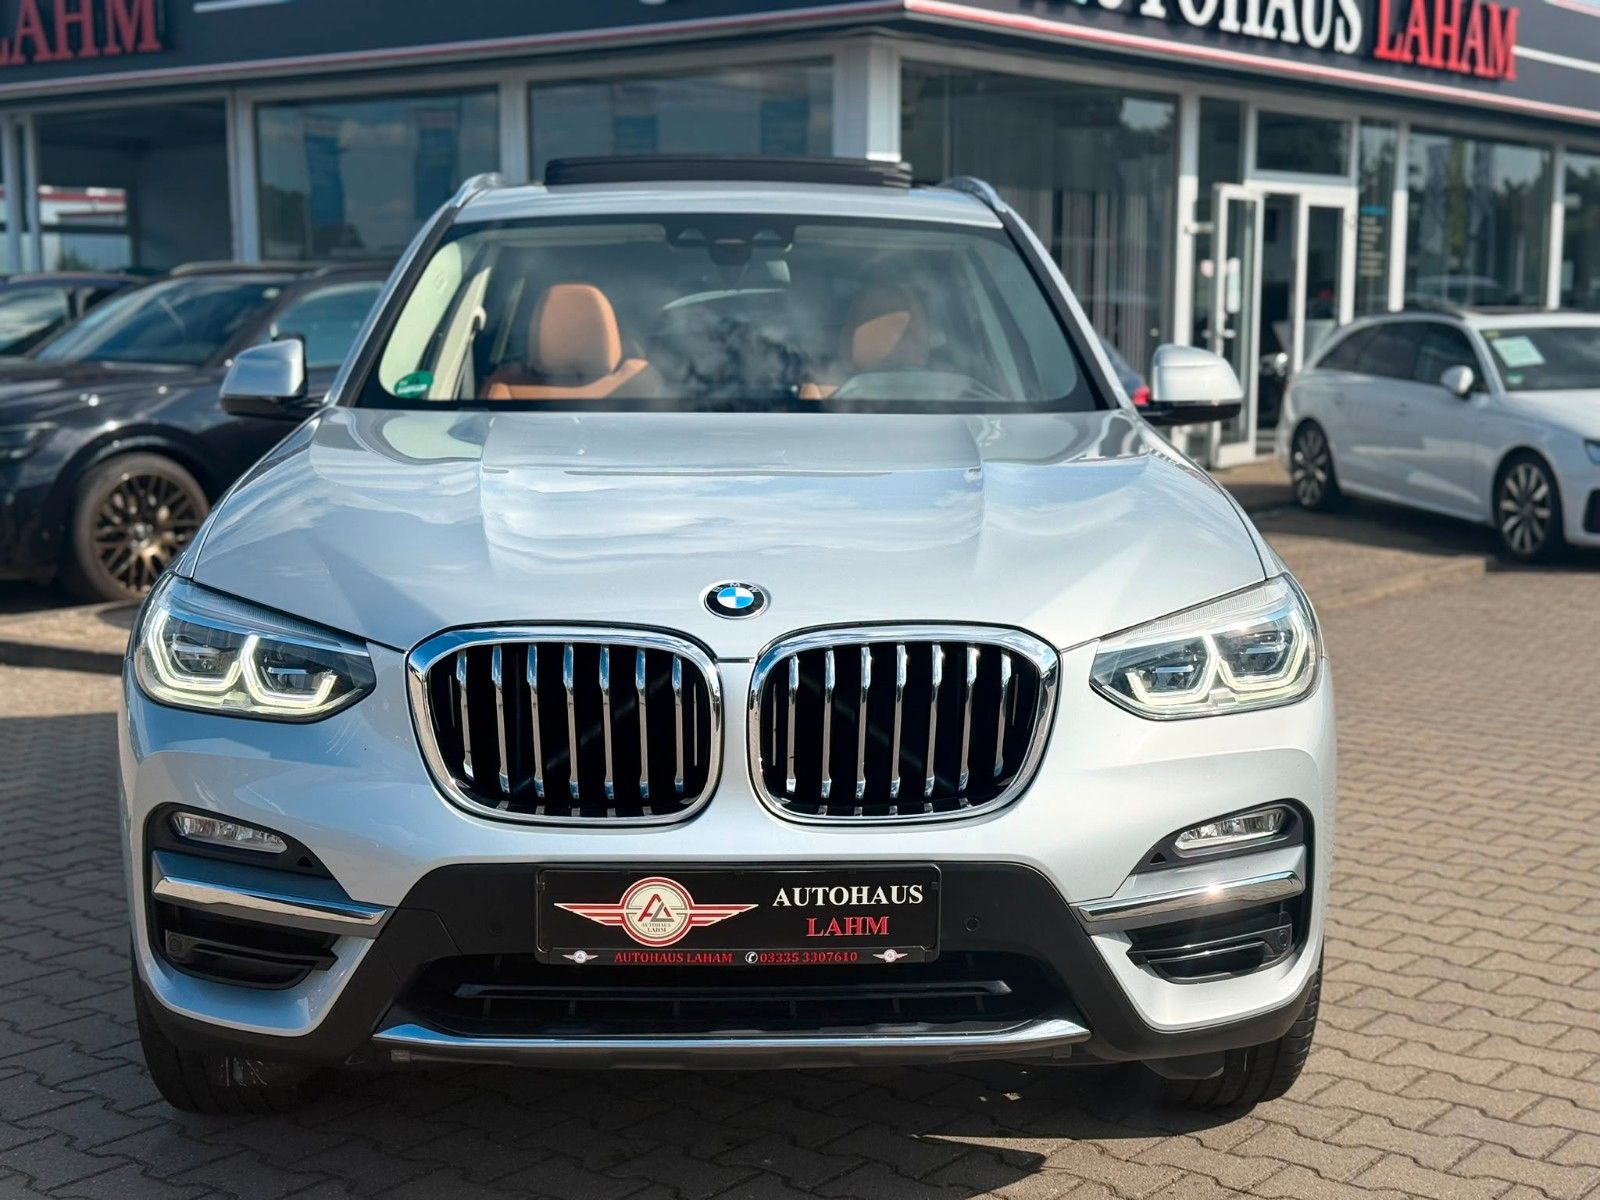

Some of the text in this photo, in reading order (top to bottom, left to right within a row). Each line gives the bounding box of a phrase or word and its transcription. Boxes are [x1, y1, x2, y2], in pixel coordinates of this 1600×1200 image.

[0, 0, 161, 65] AHM
[1374, 0, 1520, 81] LAHAM
[772, 884, 924, 906] AUTOHAUS
[806, 915, 890, 937] LAHM
[614, 952, 858, 963] AUTOHAUS LAHAM 03335 3307610
